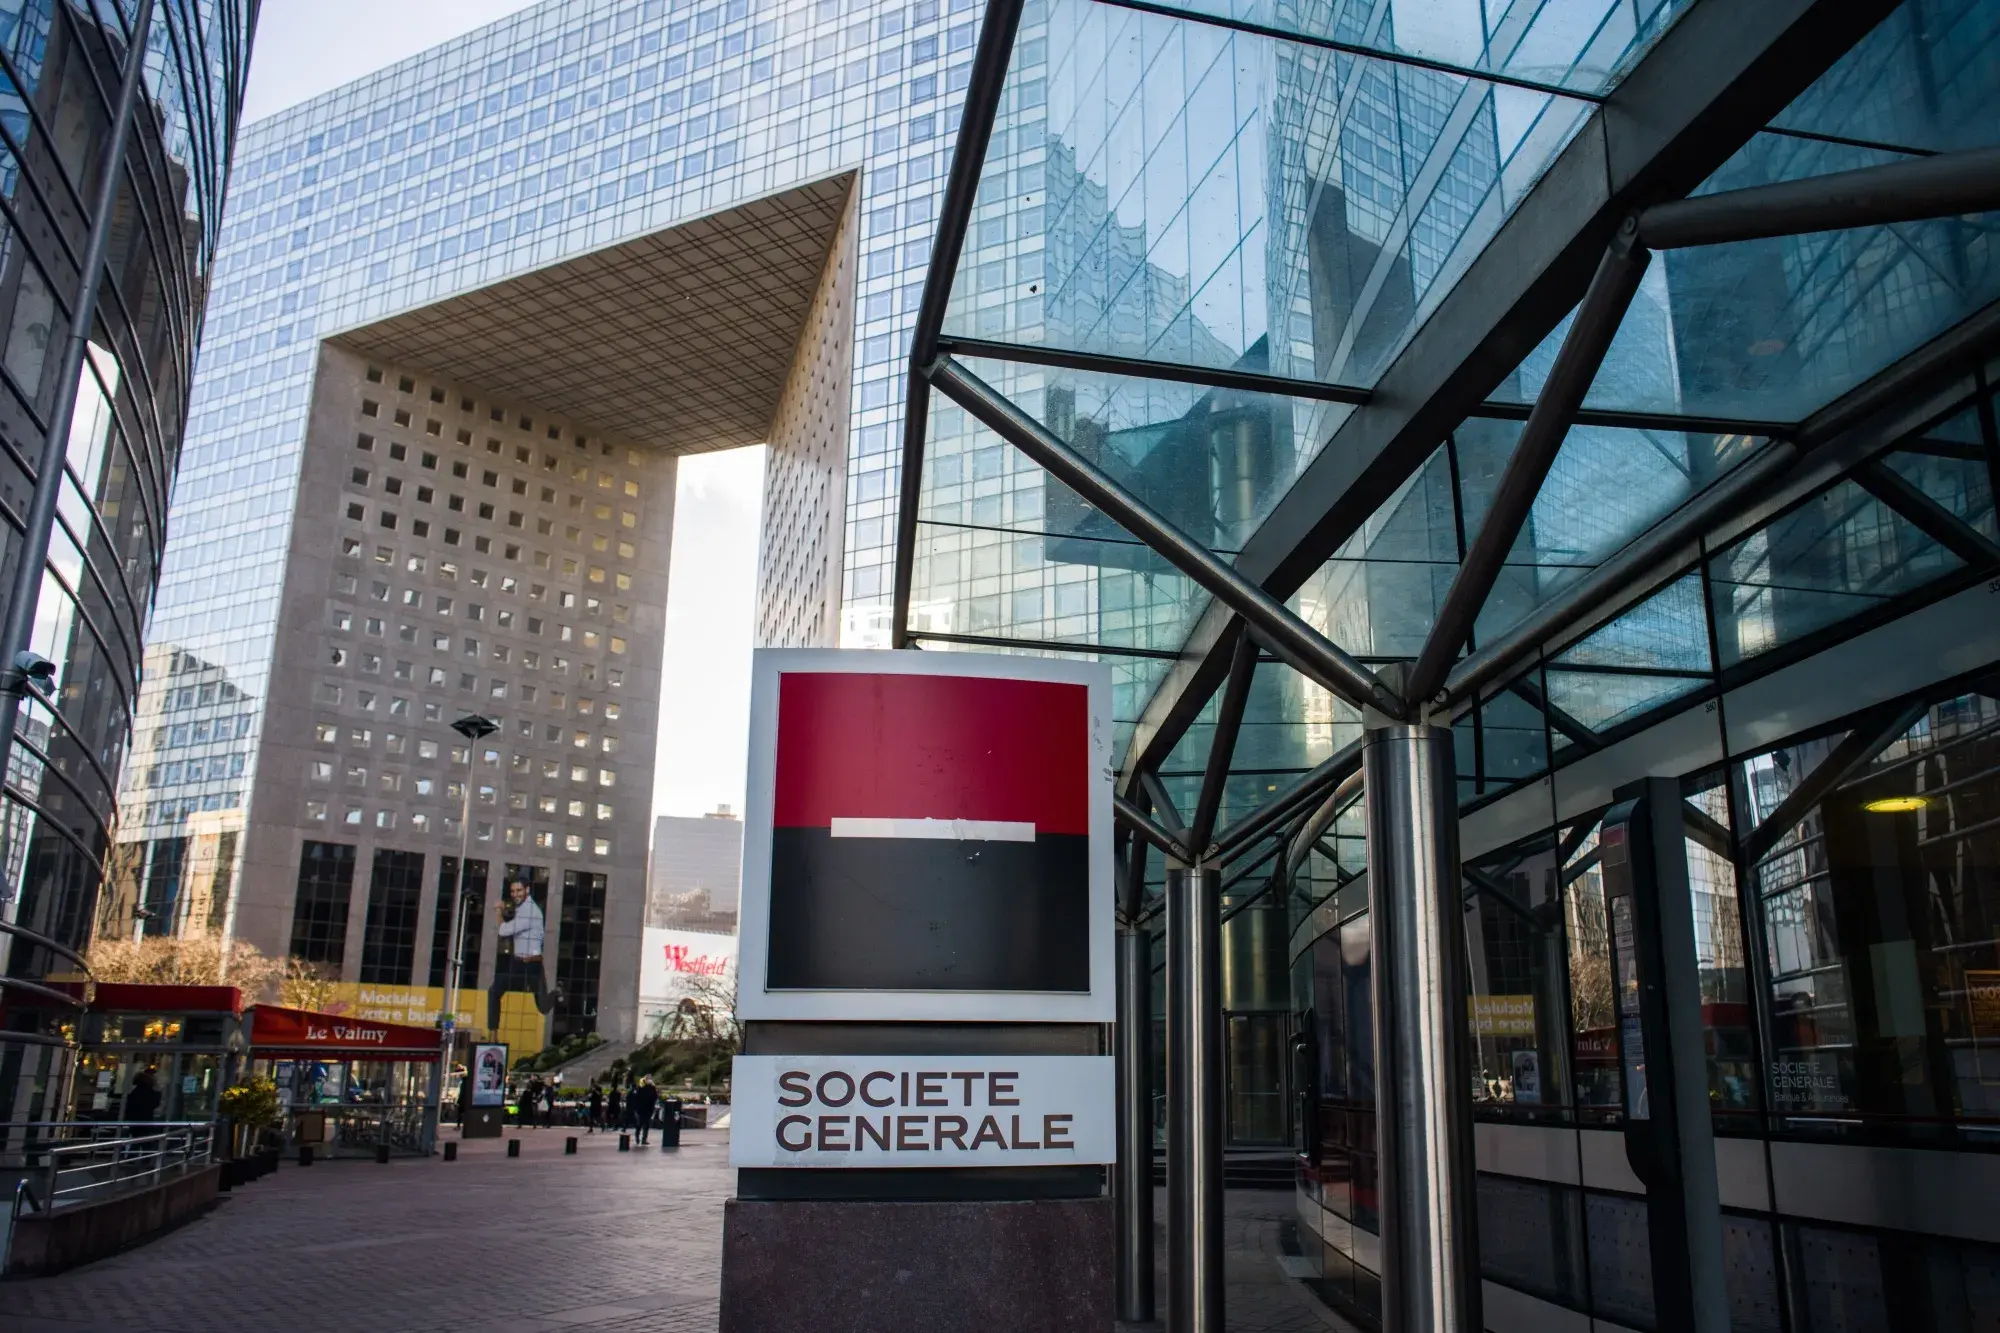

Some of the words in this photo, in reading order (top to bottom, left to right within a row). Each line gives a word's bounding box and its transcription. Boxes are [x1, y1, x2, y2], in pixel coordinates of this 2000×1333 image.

[663, 943, 728, 976] Westfield
[359, 990, 427, 1006] Modulez
[358, 1008, 403, 1021] votre
[408, 1008, 472, 1023] busiss
[305, 1026, 327, 1040] Le
[333, 1026, 388, 1044] Valmy
[1772, 1062, 1821, 1074] SOCIETE
[778, 1071, 1020, 1107] SOCIETE
[1773, 1076, 1836, 1088] GENERALE
[1808, 1092, 1849, 1104] Asrances
[776, 1114, 1075, 1152] GENERALE
